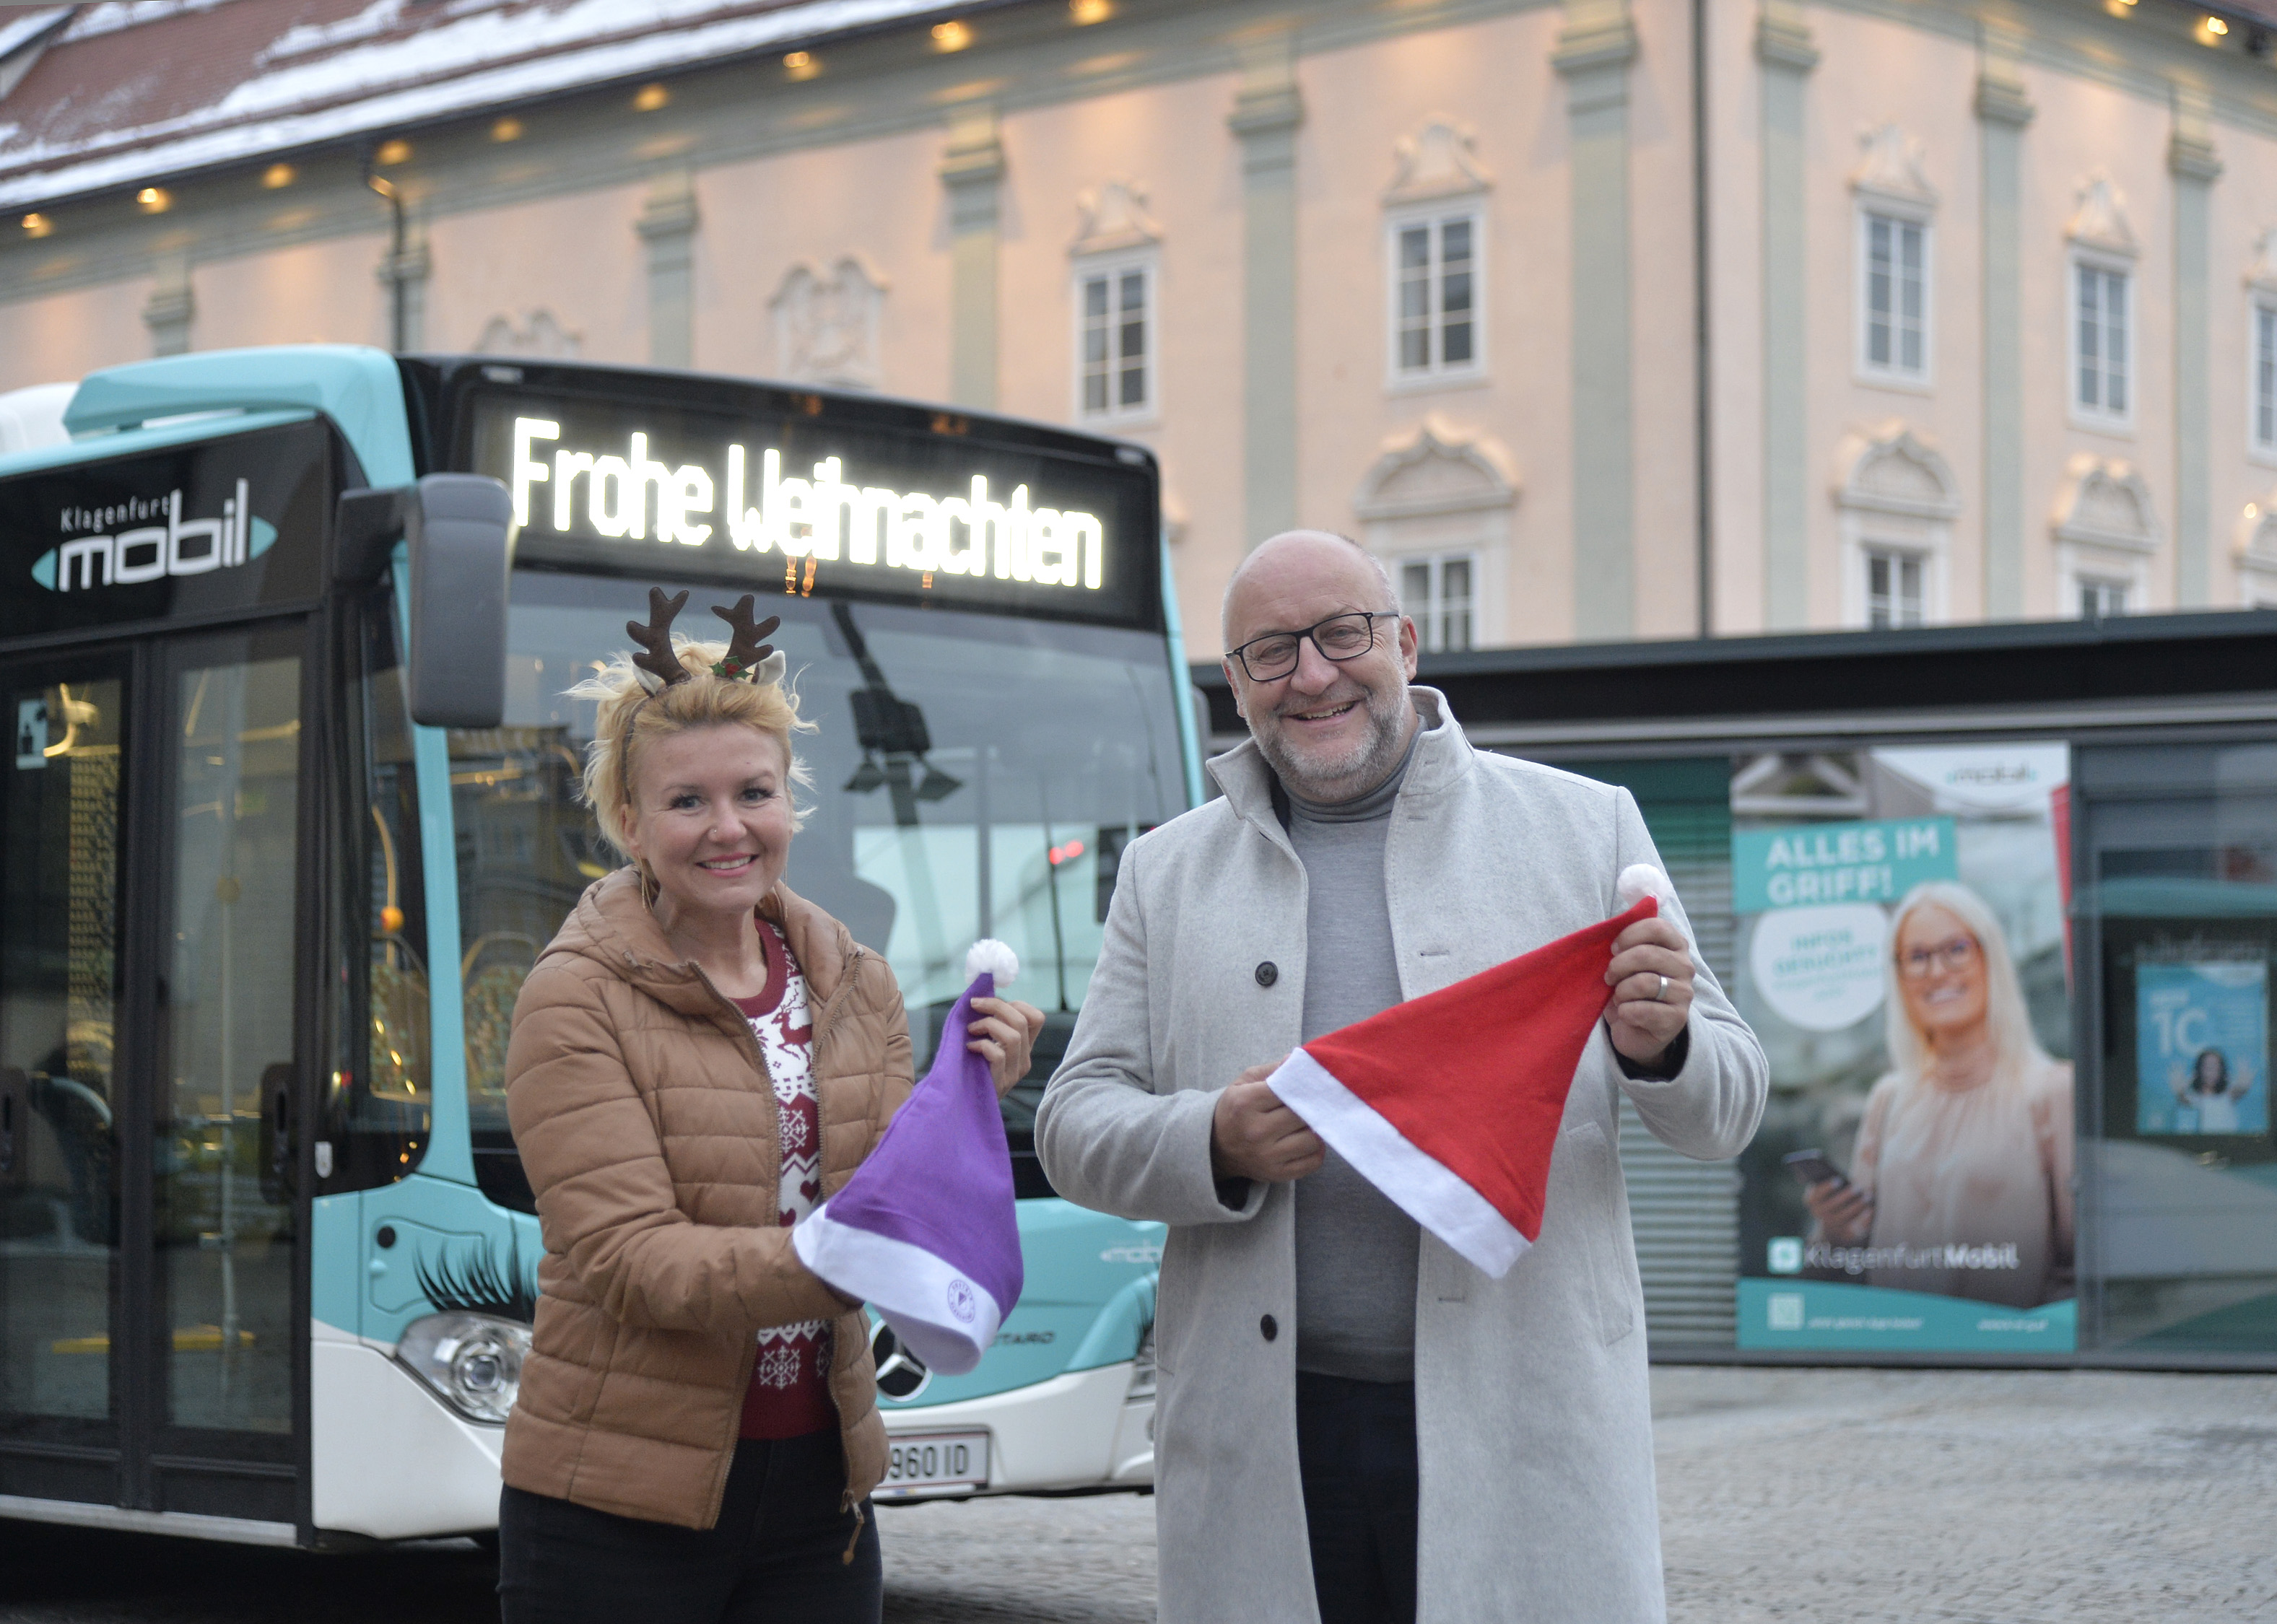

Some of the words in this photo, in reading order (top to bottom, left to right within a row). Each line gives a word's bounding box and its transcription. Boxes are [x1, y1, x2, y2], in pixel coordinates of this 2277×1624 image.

[60, 495, 170, 533] Klagenfurt
[513, 416, 714, 546] Frohe
[726, 443, 1103, 590] Weihnachten
[58, 476, 250, 593] mobil
[1767, 829, 1886, 869] ALLES
[1895, 824, 1941, 859] IM
[1767, 864, 1893, 904] GRIFF!
[1806, 1241, 2020, 1275] KlagenfurtMobil
[889, 1446, 938, 1479] 960
[944, 1444, 969, 1476] ID
